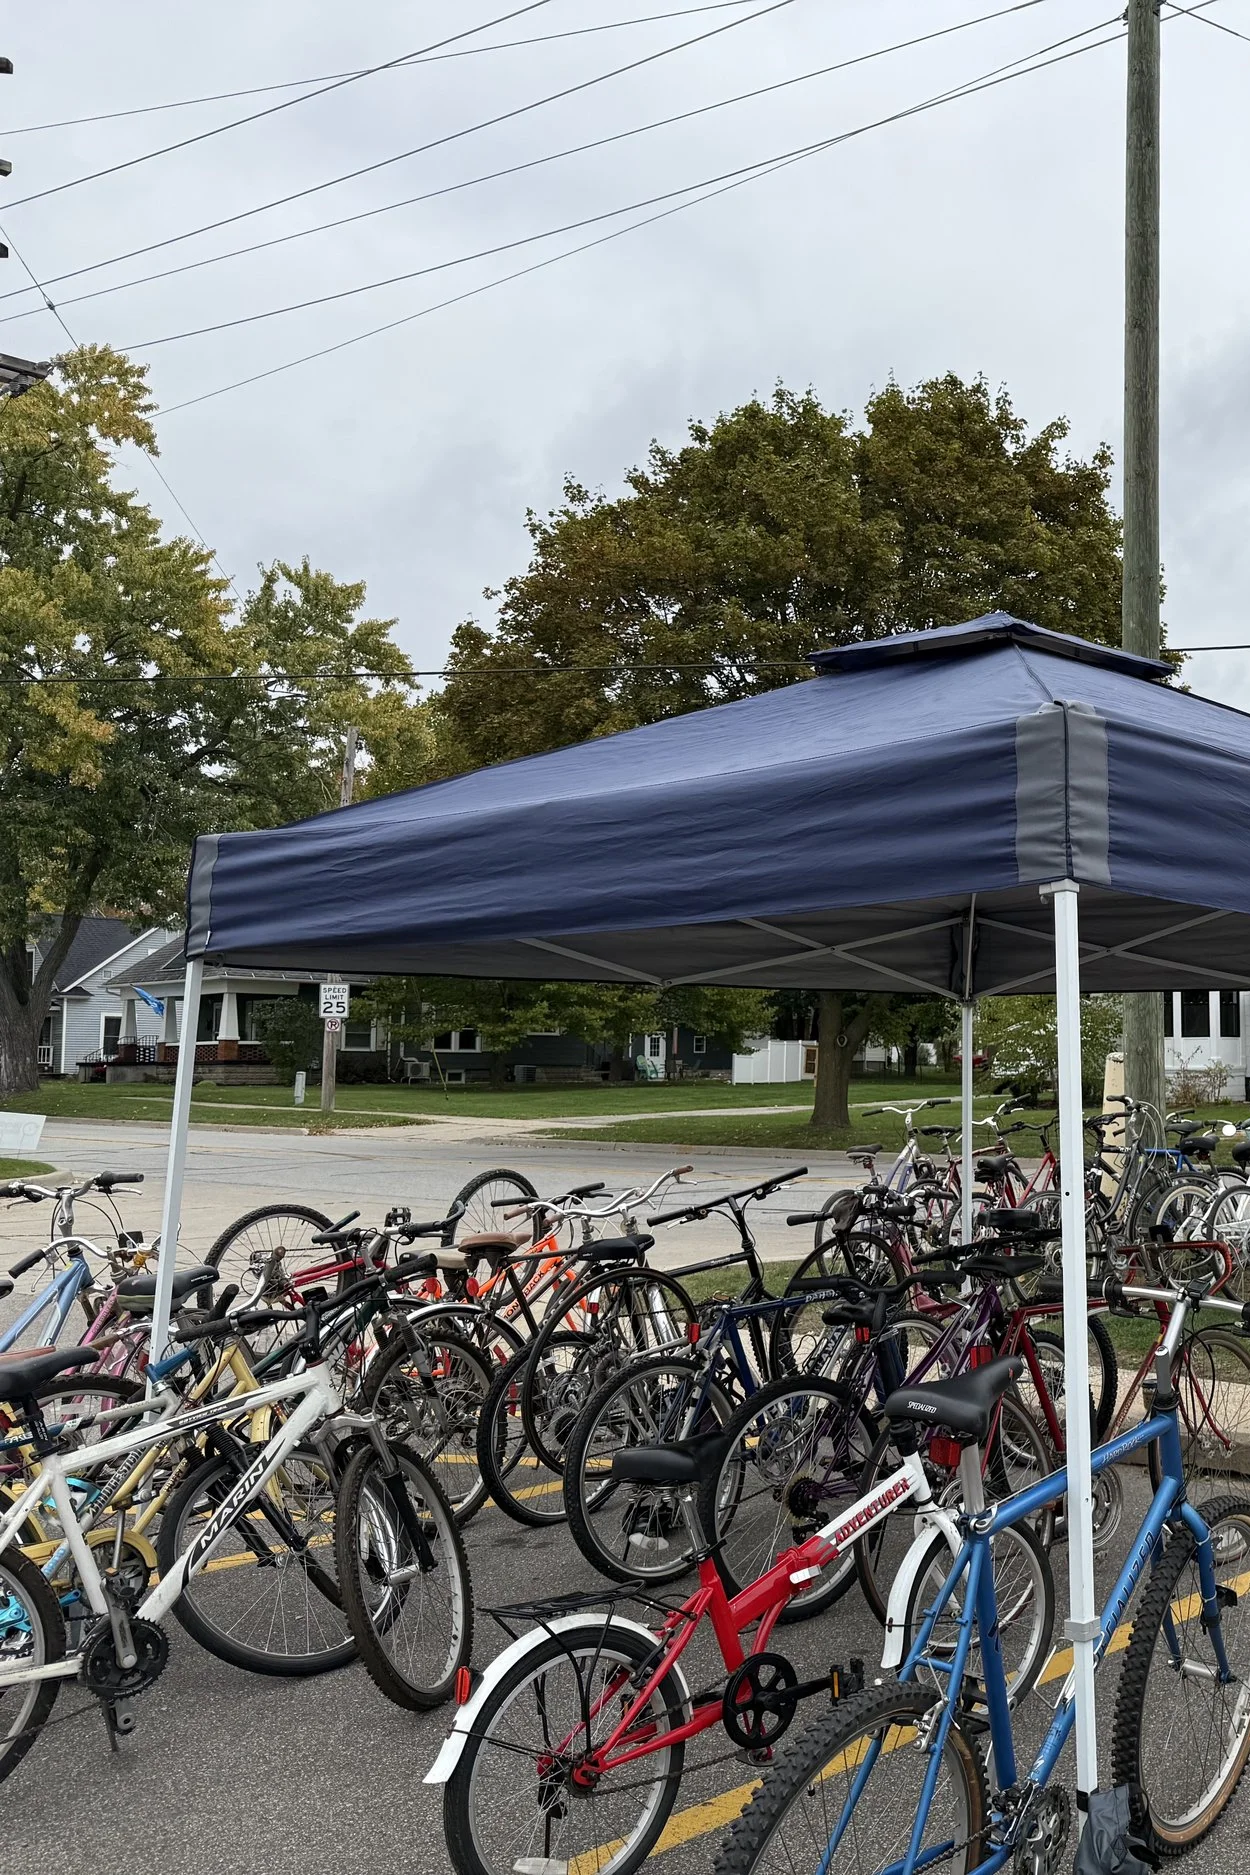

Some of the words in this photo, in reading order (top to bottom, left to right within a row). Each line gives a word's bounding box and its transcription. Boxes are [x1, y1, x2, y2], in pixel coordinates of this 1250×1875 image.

[323, 1001, 346, 1014] 25
[907, 1400, 937, 1414] SPECIALIZED
[200, 1462, 264, 1549] MARIN
[835, 1477, 911, 1546] ADVENTURER
